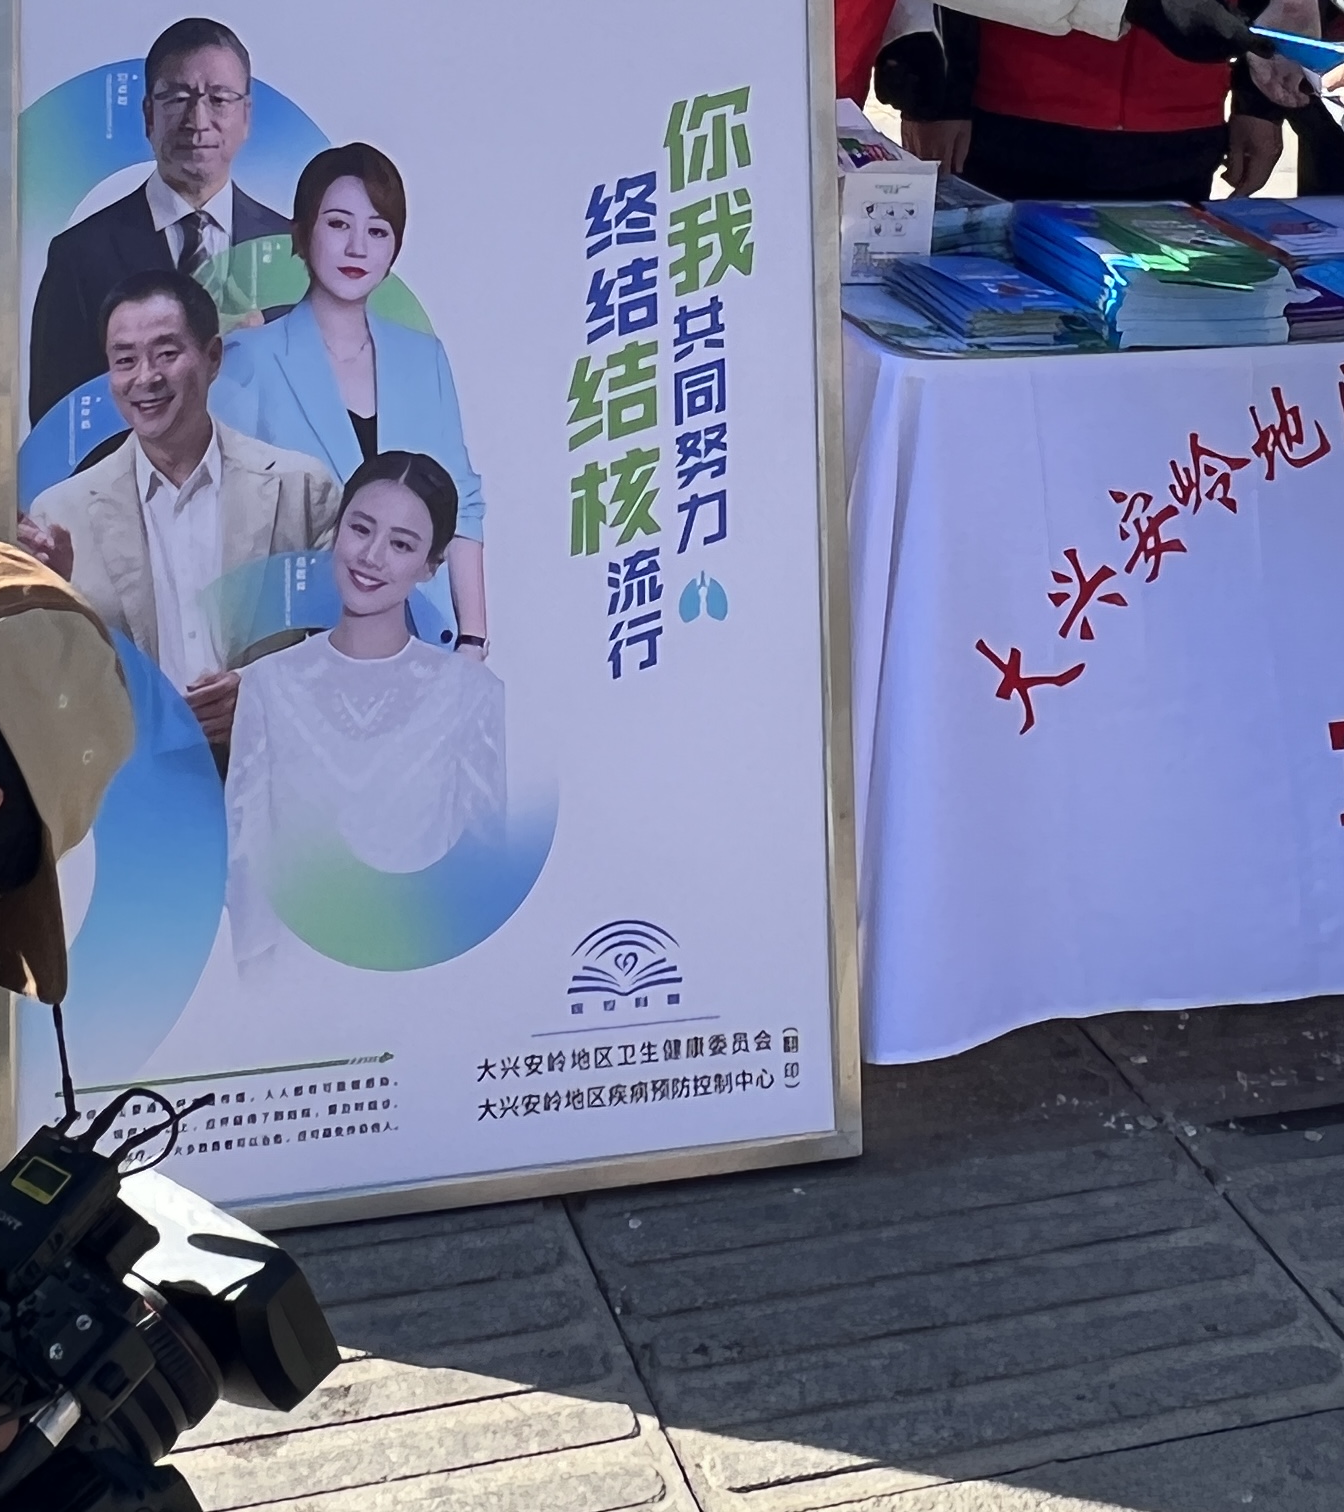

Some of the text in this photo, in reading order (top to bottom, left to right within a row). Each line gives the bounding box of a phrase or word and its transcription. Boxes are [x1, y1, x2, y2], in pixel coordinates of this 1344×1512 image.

[566, 171, 664, 681] 终结结核流行
[663, 85, 755, 555] 你我共同努力
[477, 1068, 776, 1122] 大兴安岭地区疾病预防控制中心
